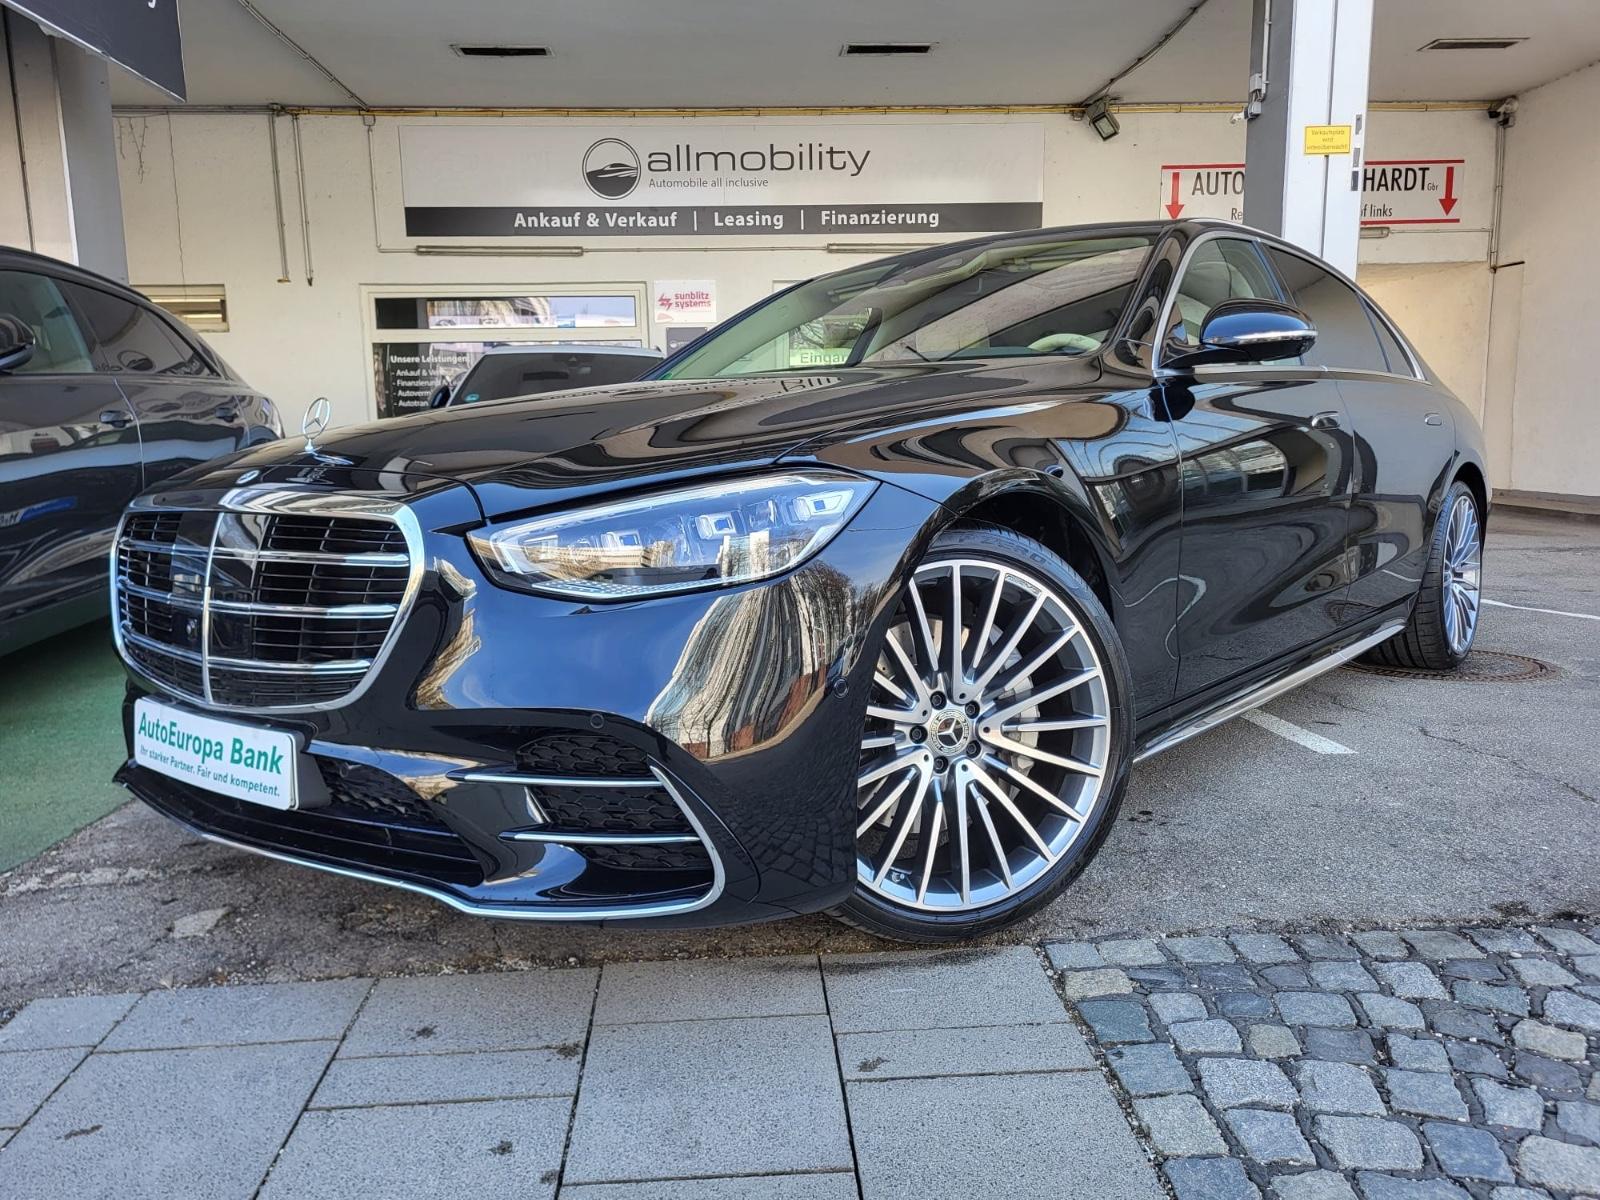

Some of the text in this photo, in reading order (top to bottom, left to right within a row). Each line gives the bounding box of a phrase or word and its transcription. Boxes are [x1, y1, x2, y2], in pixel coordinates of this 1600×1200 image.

[647, 143, 871, 177] allmobility
[649, 177, 769, 188] Automobile all inclusive
[1191, 170, 1246, 196] AUTO
[1369, 203, 1393, 217] links
[514, 209, 940, 230] Ankauf & Verkauf Leasing Finanzierung
[674, 290, 710, 300] sunblitz
[674, 300, 711, 310] systems
[390, 355, 420, 363] Unsere
[138, 711, 284, 775] AutoEuropa Bank
[149, 751, 170, 764] starker
[170, 755, 196, 775] Partner.
[196, 765, 212, 779] Fair
[213, 773, 228, 784] und
[230, 774, 281, 797] kompetent.
